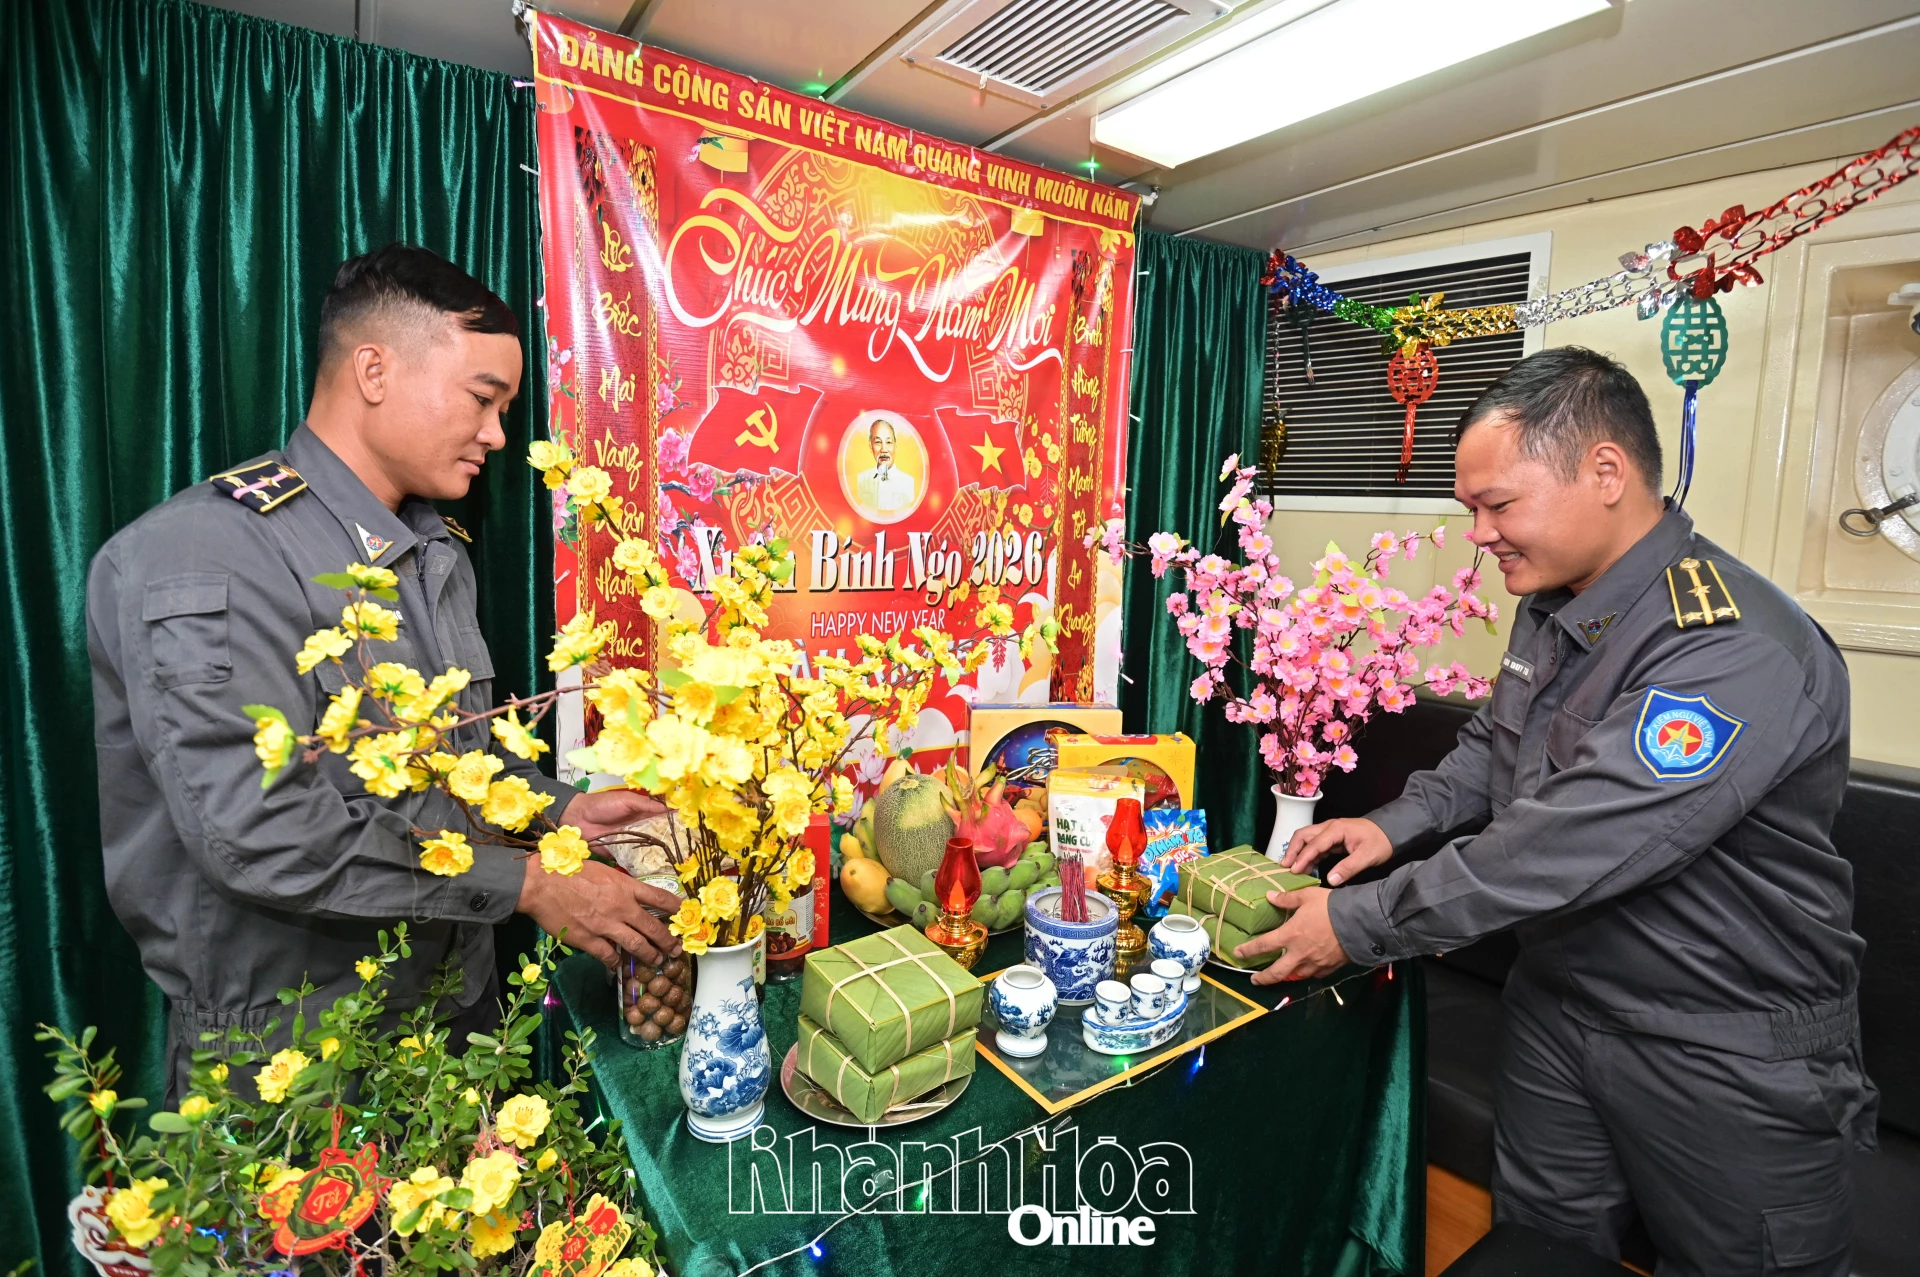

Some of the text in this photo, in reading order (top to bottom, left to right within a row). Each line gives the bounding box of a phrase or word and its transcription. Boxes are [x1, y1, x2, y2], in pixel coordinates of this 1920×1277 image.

[558, 30, 1129, 222] ĐẢNG CỘNG SẢN VIỆT NAM QUANG VINH MUÔN NĂM
[600, 220, 634, 272] Lộc
[665, 198, 796, 330] Chúc
[796, 228, 904, 362] Mừng
[591, 291, 642, 337] Biếc
[597, 364, 636, 413] Mai
[1071, 363, 1101, 413] Hùng
[594, 427, 644, 492] Vàng
[1067, 463, 1094, 500] Mạnh
[808, 529, 895, 593] Bính
[969, 529, 1045, 588] 2026
[1067, 558, 1083, 590] An
[810, 607, 946, 638] HAPPY NEW YEAR
[1056, 602, 1093, 647] Khang
[1174, 849, 1189, 863] BIG
